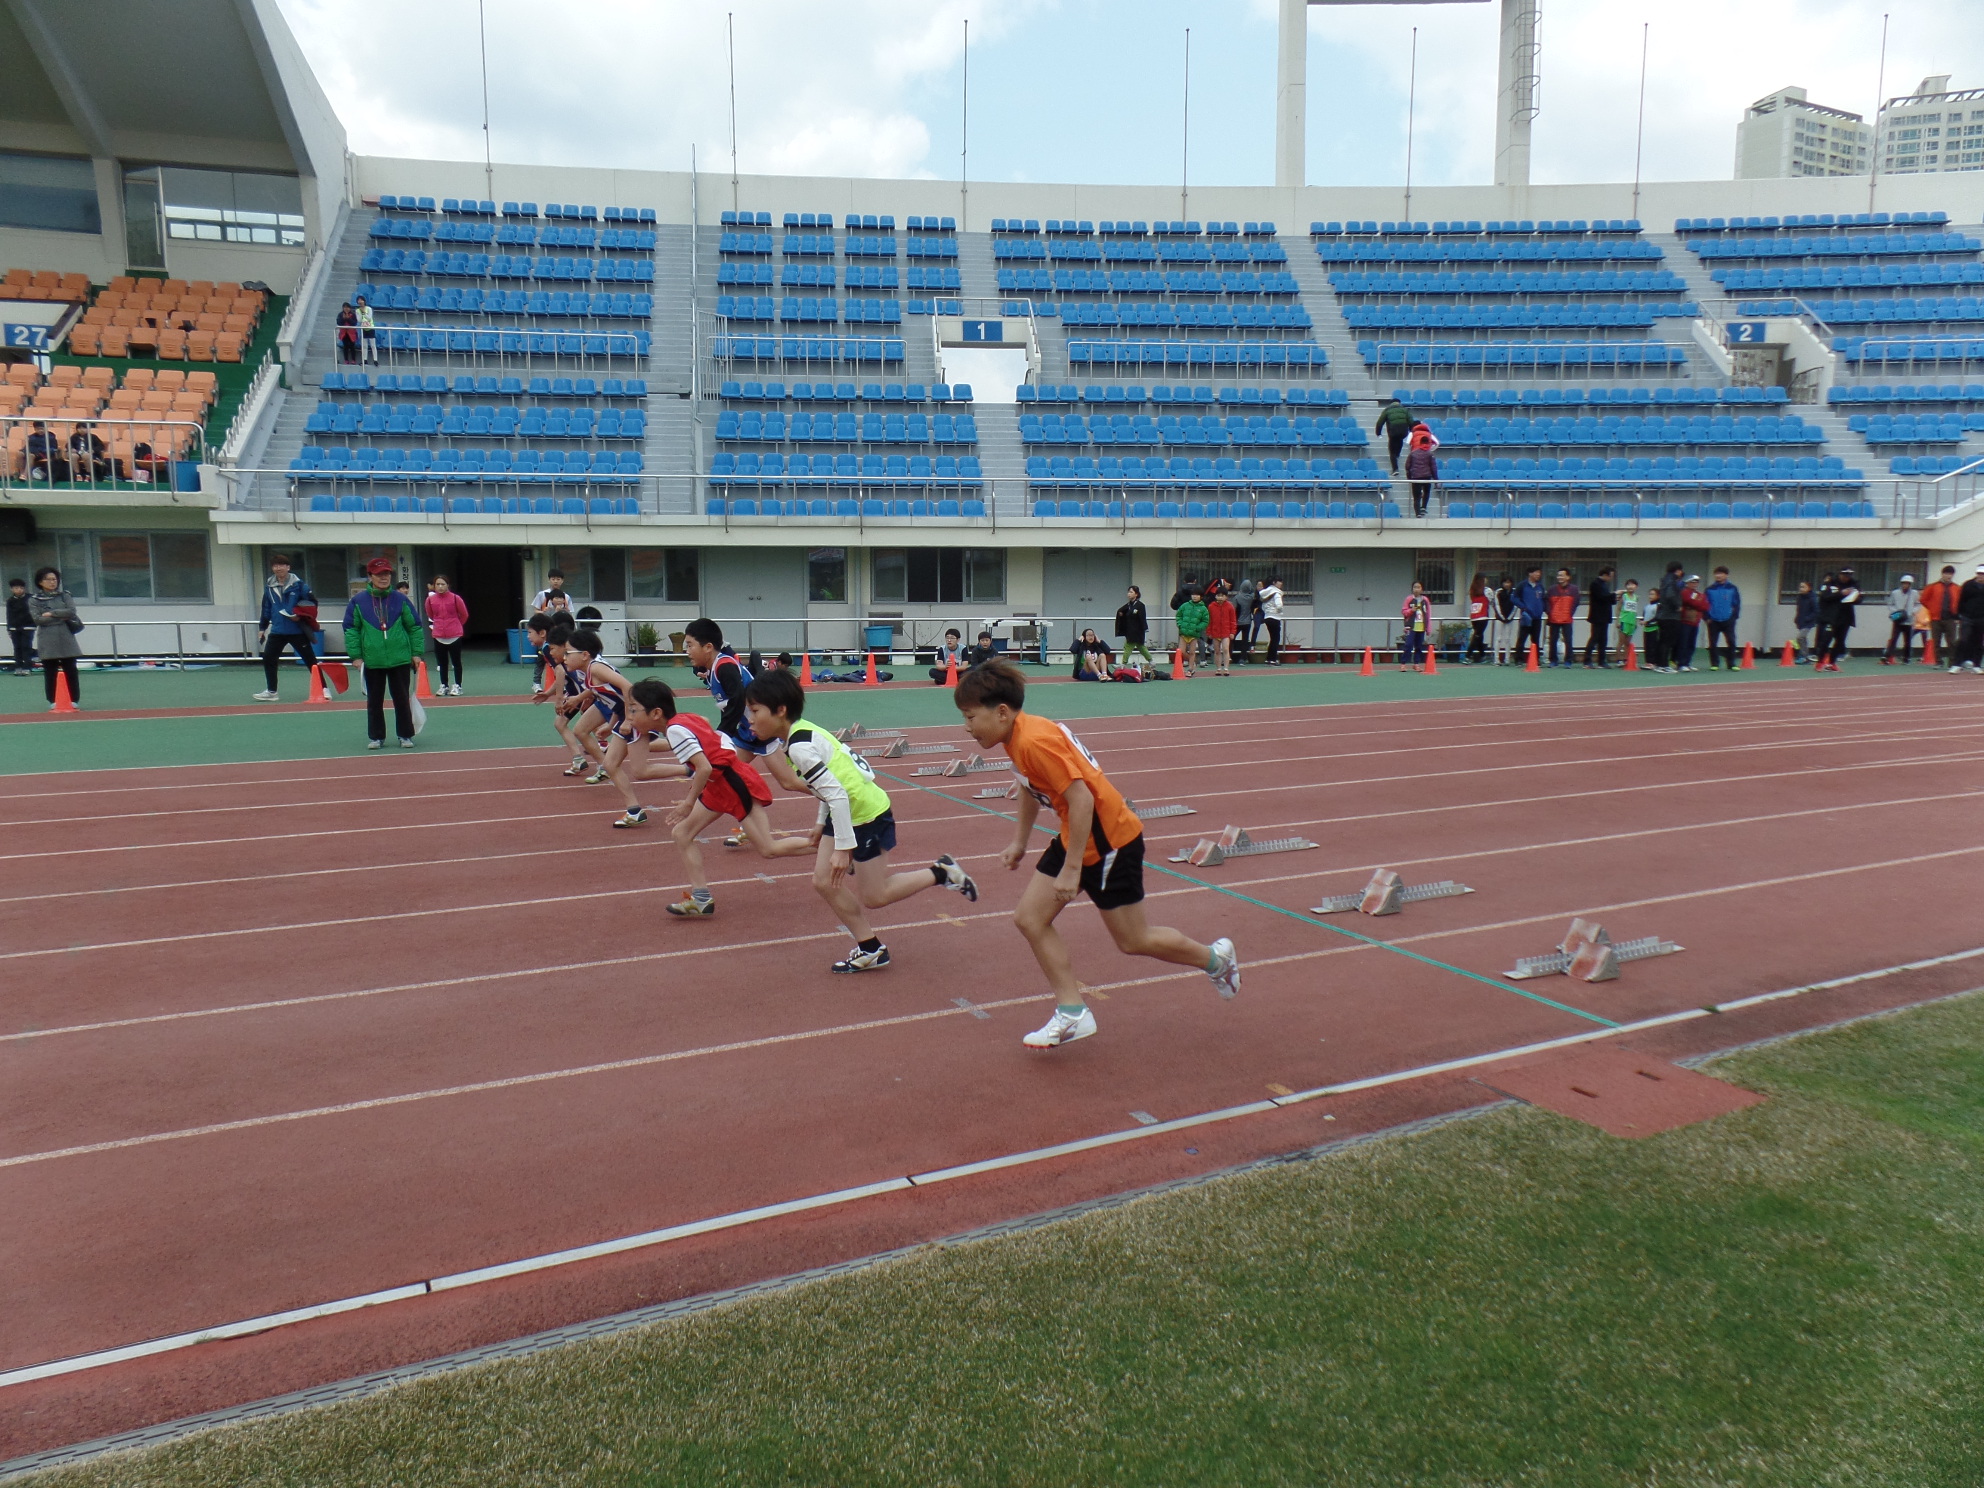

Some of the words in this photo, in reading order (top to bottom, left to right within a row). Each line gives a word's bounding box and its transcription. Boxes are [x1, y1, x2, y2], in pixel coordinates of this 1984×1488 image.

[14, 325, 47, 346] 27
[977, 322, 985, 340] 1
[1739, 323, 1753, 341] 2
